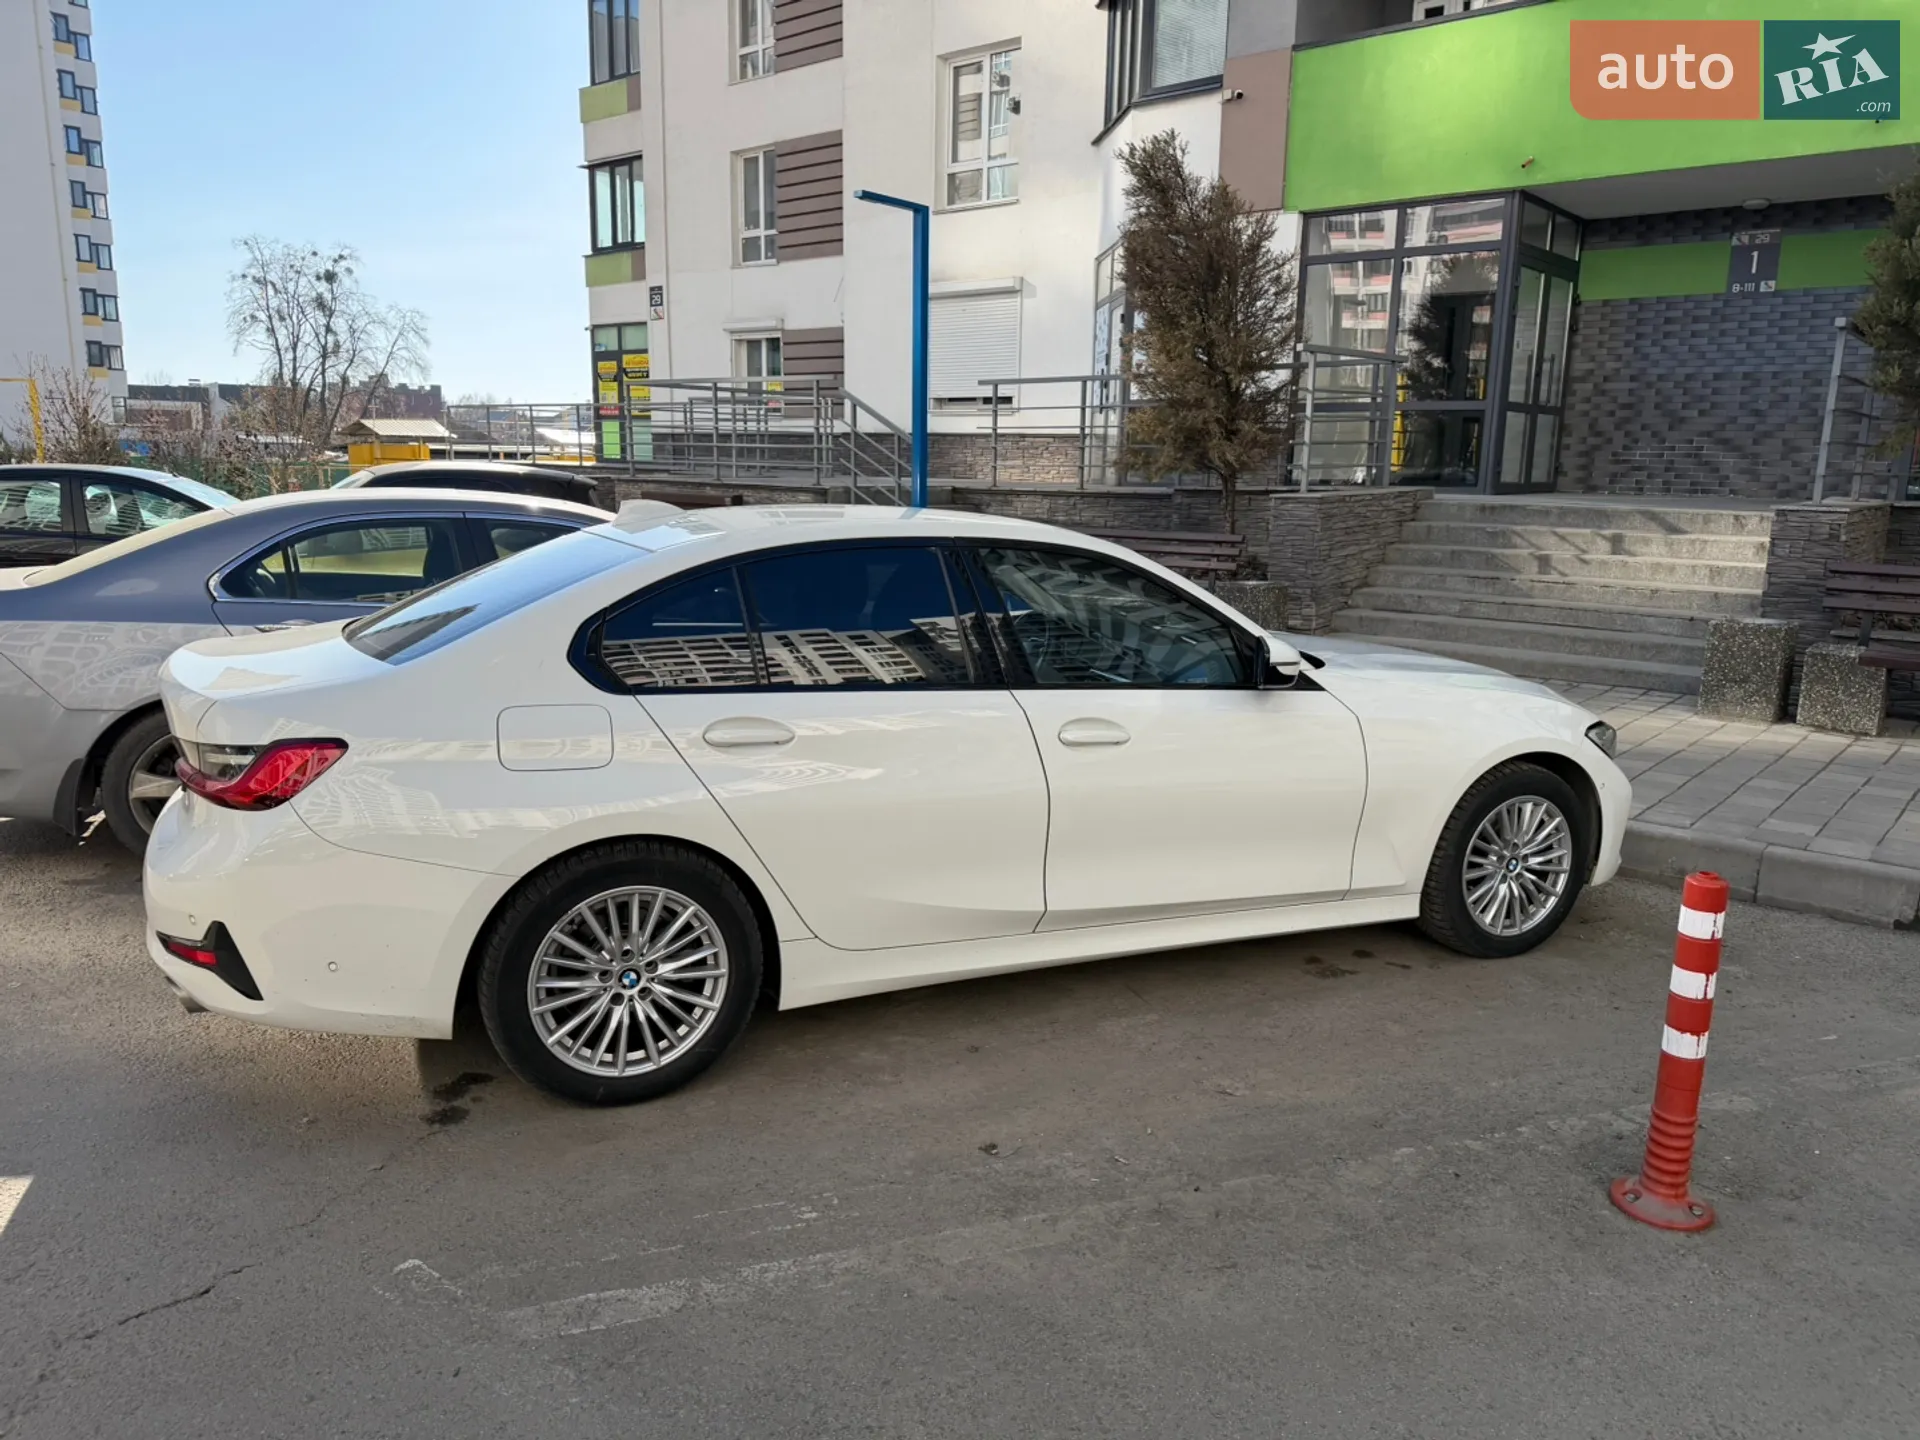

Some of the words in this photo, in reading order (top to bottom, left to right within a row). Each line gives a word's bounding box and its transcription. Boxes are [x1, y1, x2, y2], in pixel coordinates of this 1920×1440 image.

[1755, 233, 1770, 244] 29
[1751, 250, 1759, 274] 1
[651, 294, 662, 305] 29
